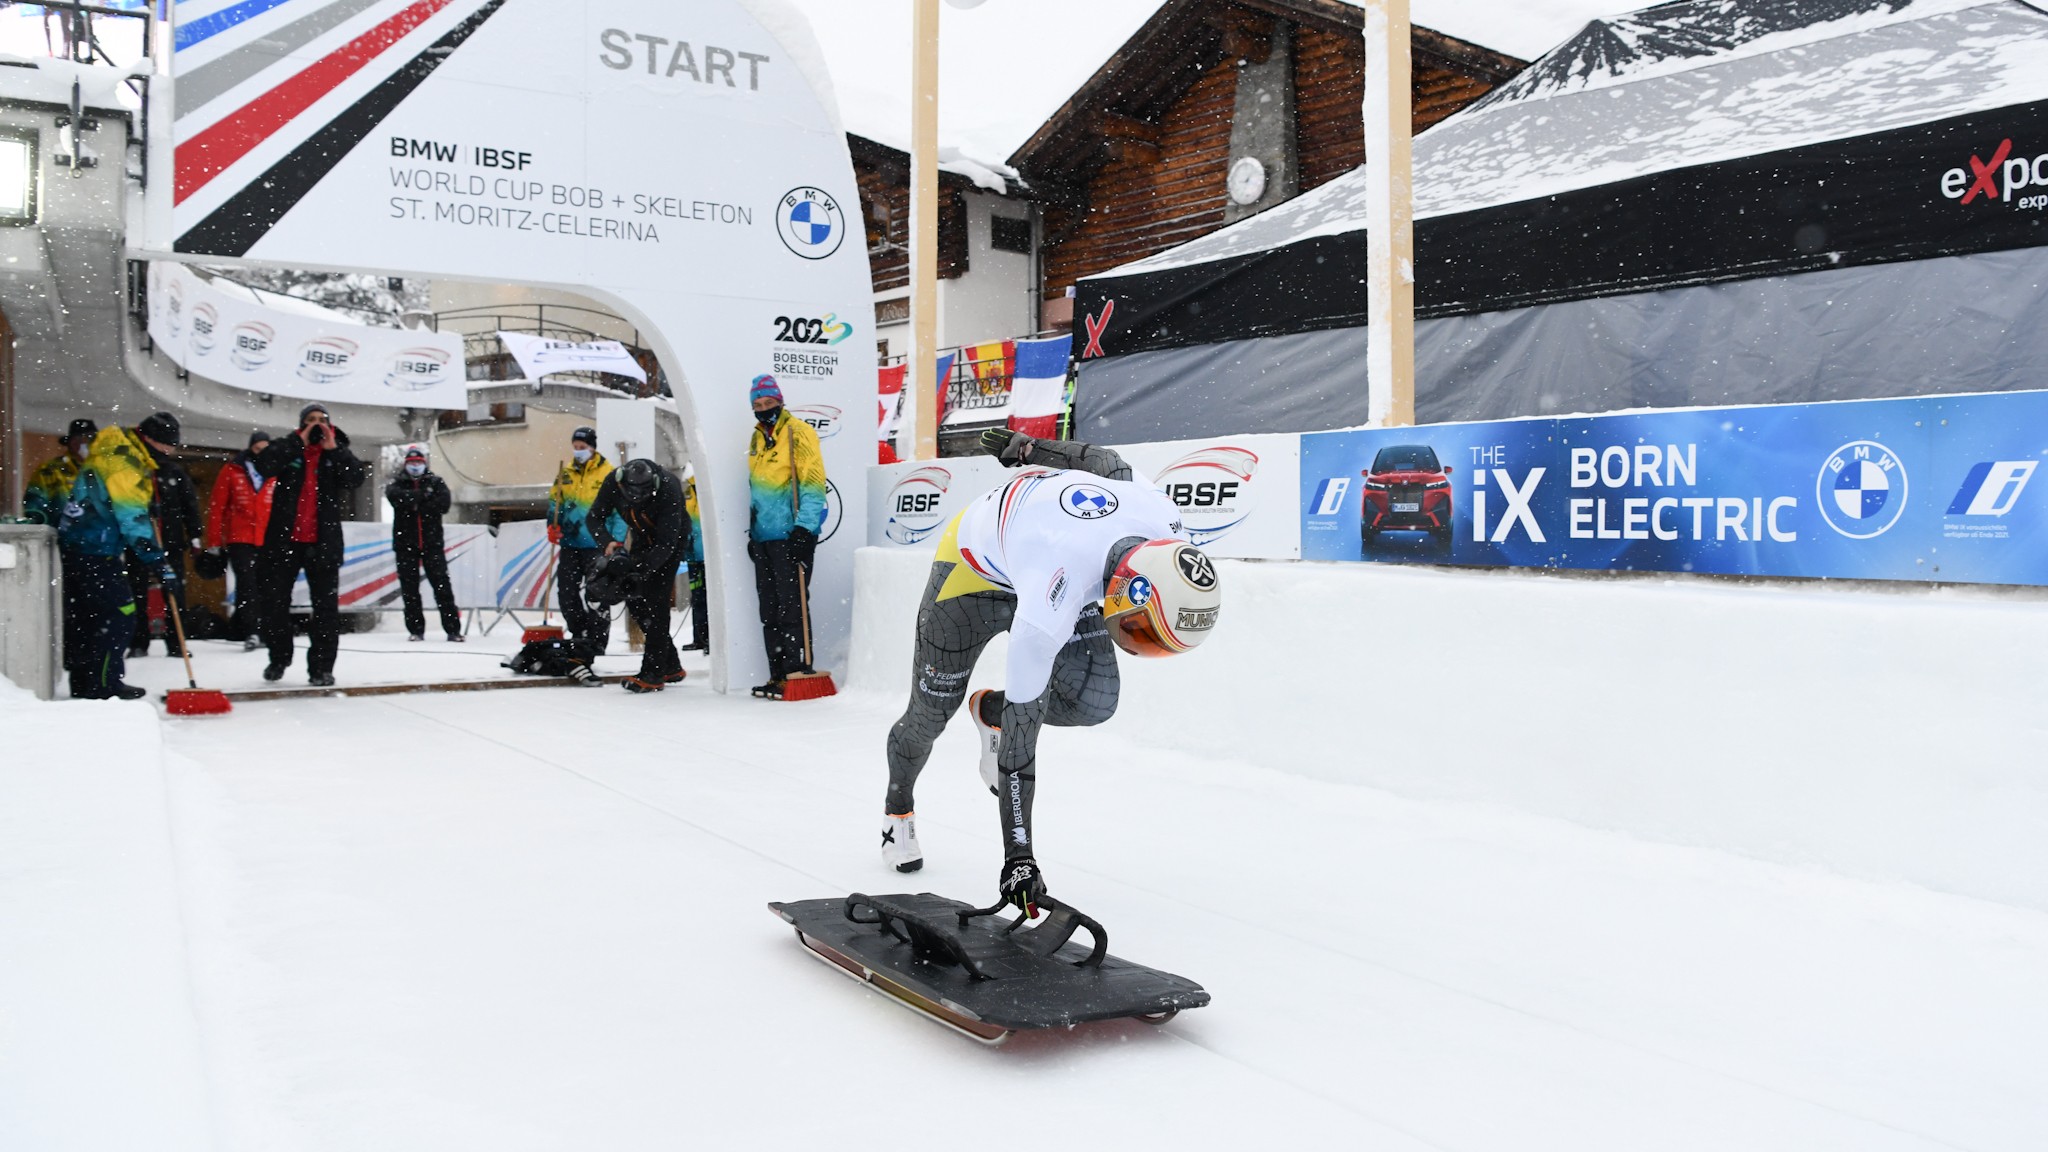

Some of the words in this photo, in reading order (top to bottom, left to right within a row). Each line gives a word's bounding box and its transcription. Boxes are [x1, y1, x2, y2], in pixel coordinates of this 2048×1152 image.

[599, 28, 770, 91] START
[390, 136, 457, 163] BMW
[475, 146, 532, 171] IBSF
[390, 166, 485, 196] WORLD
[494, 178, 543, 201] CUP
[552, 184, 604, 209] BOB
[633, 193, 752, 225] SKELETON
[390, 197, 426, 220] ST.
[435, 201, 660, 243] MORITZ-CELERINA
[305, 349, 349, 366] IBSF
[395, 360, 441, 374] IBSF
[773, 352, 839, 366] BOBSLEIGH
[773, 363, 834, 376] SKELETON
[804, 418, 831, 429] SF
[1469, 445, 1505, 465] THE
[1570, 443, 1697, 488] BORN
[896, 493, 940, 513] IBSF
[1473, 467, 1547, 543] iX
[1569, 496, 1797, 542] ELECTRIC
[1178, 611, 1219, 627] MUNIC
[1081, 629, 1109, 639] IBERDRO
[1010, 770, 1024, 826] IBERDROLA
